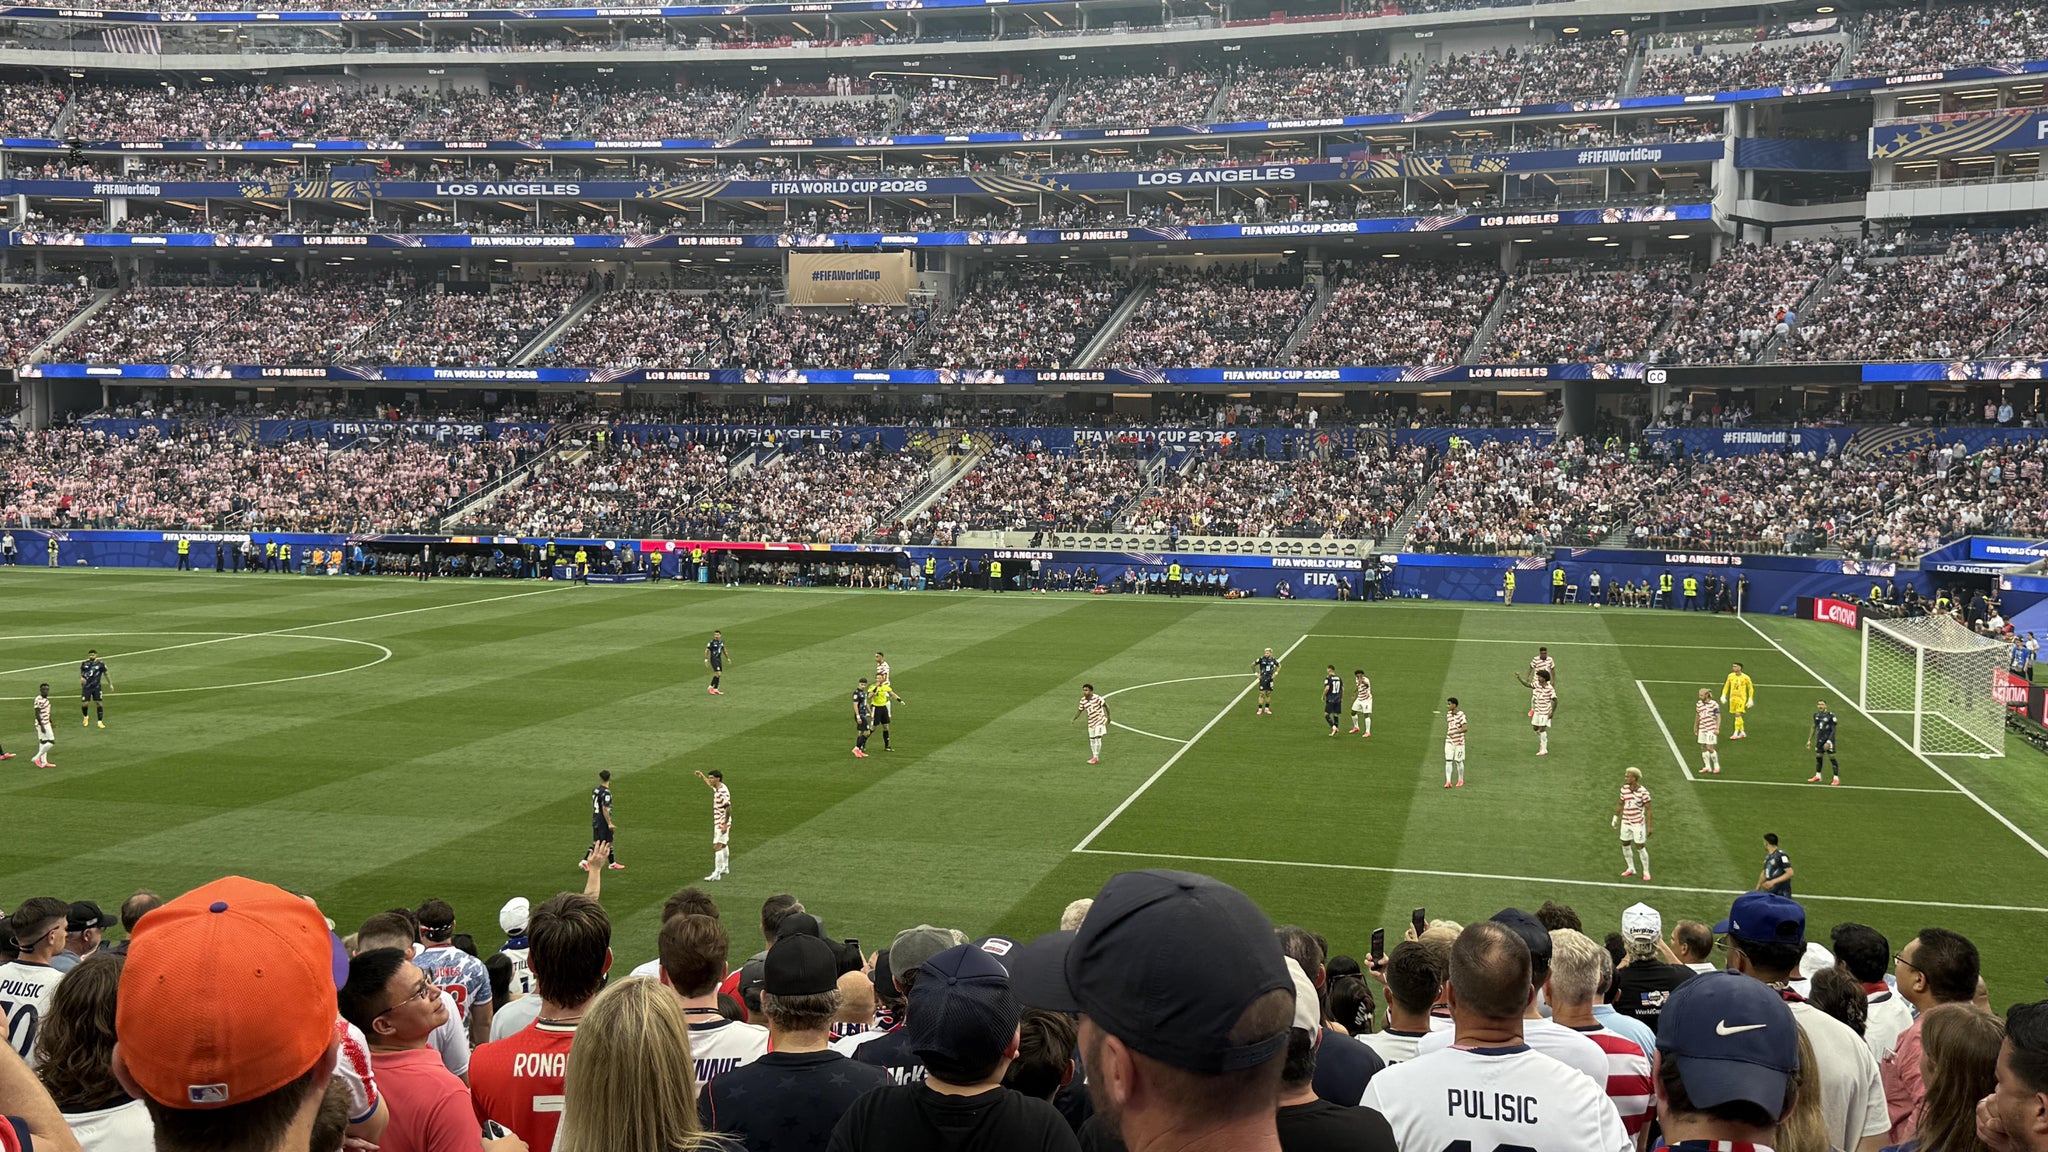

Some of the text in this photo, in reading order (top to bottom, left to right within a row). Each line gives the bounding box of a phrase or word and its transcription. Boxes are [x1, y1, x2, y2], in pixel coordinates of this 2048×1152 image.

[1578, 148, 1661, 164] #FIFAWorldCup
[1138, 168, 1295, 185] LOS ANGELES
[93, 184, 160, 197] #FIFAWorldCup
[436, 184, 581, 196] LOS ANGELES
[771, 181, 928, 194] FIFA WORLD CUP 2026
[1480, 214, 1559, 227] LOS ANGELES
[1060, 231, 1128, 241] LOS ANGELES
[1242, 226, 1262, 236] FIFA
[1264, 225, 1300, 235] WORLD
[1301, 224, 1321, 233] CUP
[471, 237, 489, 245] FIFA
[491, 237, 522, 245] WORLD
[812, 270, 881, 282] #FIFAWorldCup
[262, 368, 326, 376] LOS ANGELES
[434, 370, 453, 378] FIFA
[454, 370, 486, 378] WORLD
[646, 372, 710, 380] LOS ANGELES
[1038, 372, 1104, 380] LOS ANGELES
[1224, 372, 1244, 380] FIFA
[1246, 372, 1282, 380] WORLD
[1283, 371, 1303, 379] CUP
[1469, 368, 1548, 378] LOS ANGELES
[1649, 372, 1664, 382] CC
[333, 424, 361, 434] FIFA
[1073, 431, 1102, 442] FIFA
[1158, 431, 1186, 442] CUP
[993, 551, 1053, 560] LOS ANGELES
[1666, 554, 1687, 563] LOS
[1273, 558, 1292, 566] FIFA
[1293, 559, 1325, 567] WORLD
[1326, 559, 1345, 567] CUP
[1304, 573, 1338, 586] FIFA
[1817, 600, 1855, 627] Lenovo
[434, 967, 462, 979] JONES
[0, 980, 44, 999] PULISIC
[513, 1053, 570, 1078] RONA
[693, 1057, 742, 1081] NNIE
[1447, 1088, 1538, 1124] PULISIC
